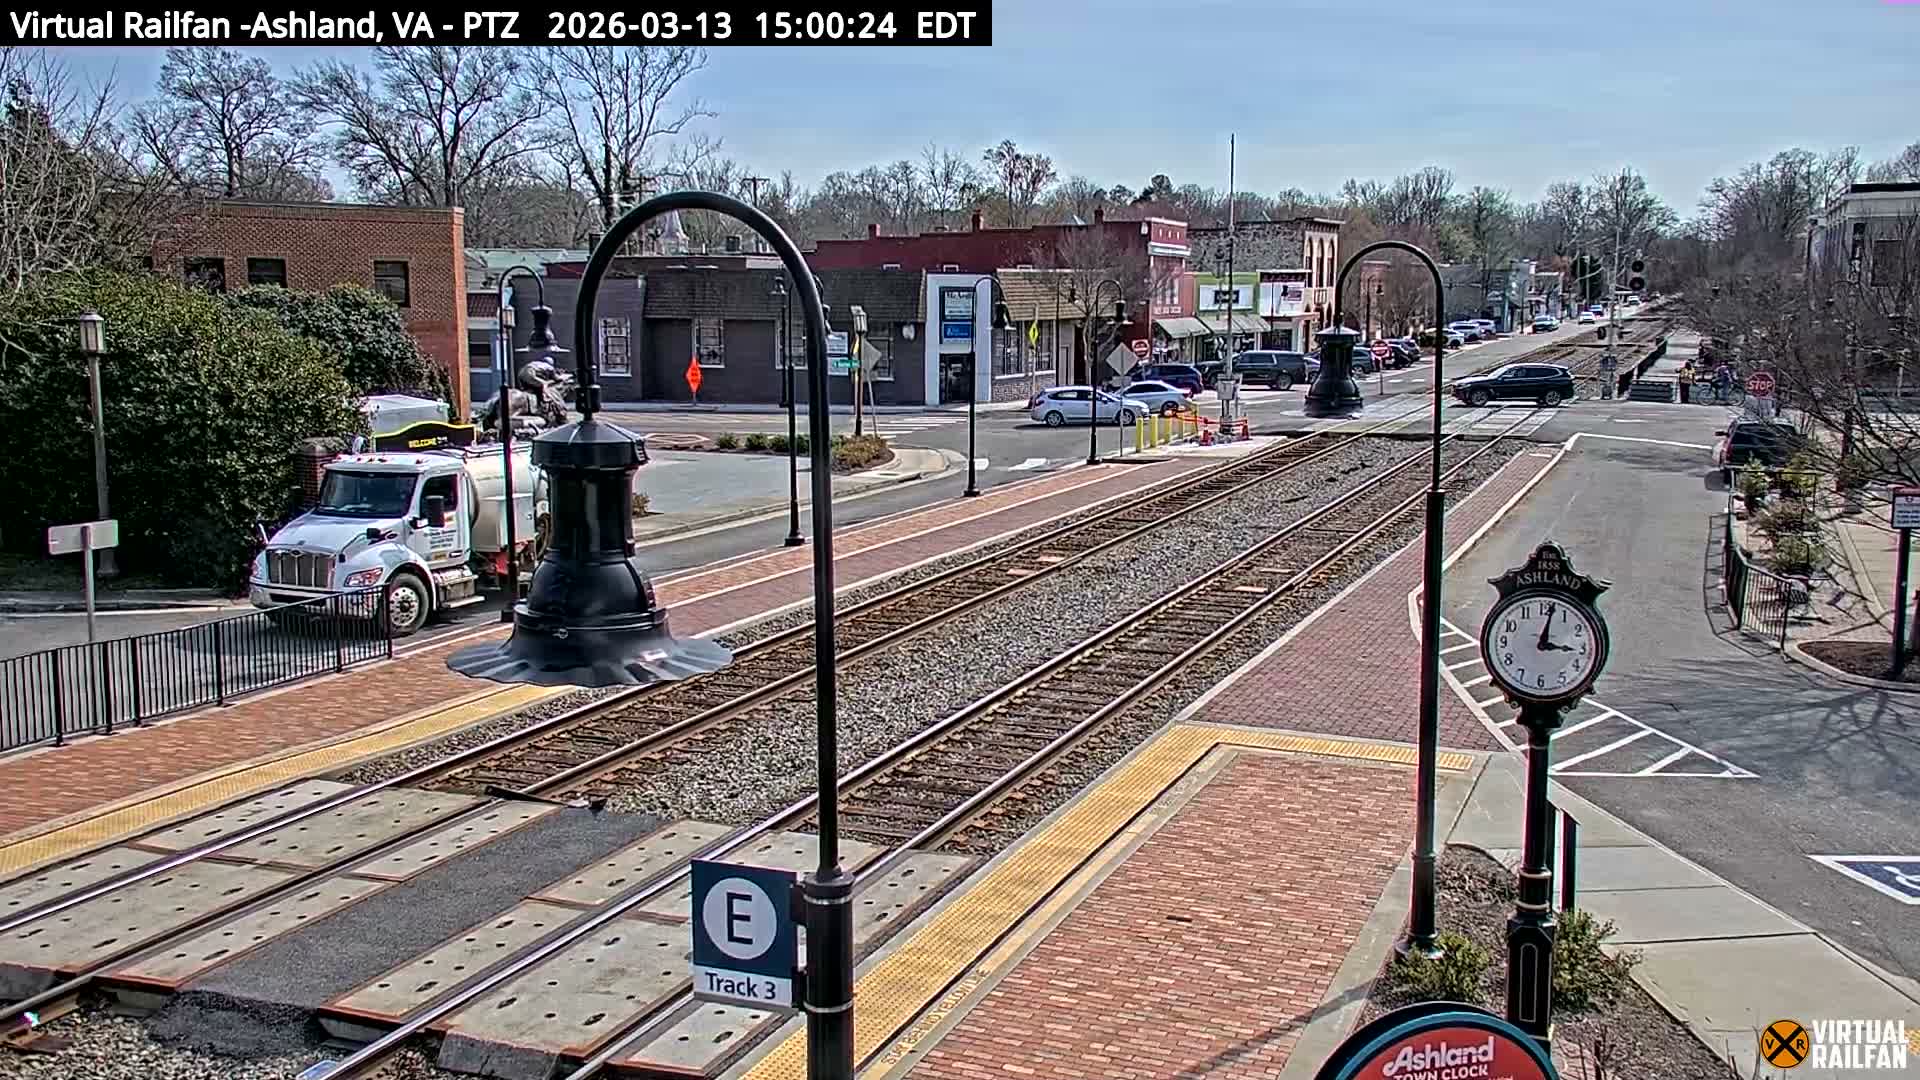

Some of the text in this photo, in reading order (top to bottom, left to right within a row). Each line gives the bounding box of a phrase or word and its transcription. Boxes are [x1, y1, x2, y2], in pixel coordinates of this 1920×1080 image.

[1748, 381, 1773, 390] STOP
[1517, 571, 1581, 590] ASHLAND
[1522, 607, 1530, 619] 11
[1562, 610, 1567, 623] 1
[1506, 620, 1517, 632] 10
[1575, 624, 1582, 637] 2
[1500, 636, 1507, 648] 9
[1579, 643, 1586, 655] 3
[1504, 653, 1513, 666] 8
[1572, 659, 1580, 672] 4
[1518, 668, 1525, 680] 7
[1557, 672, 1567, 685] 5
[1537, 675, 1544, 687] 6
[726, 891, 753, 945] E
[705, 972, 776, 1000] Track 3
[1382, 1036, 1494, 1076] Ashland
[1441, 1063, 1488, 1080] CLOCK
